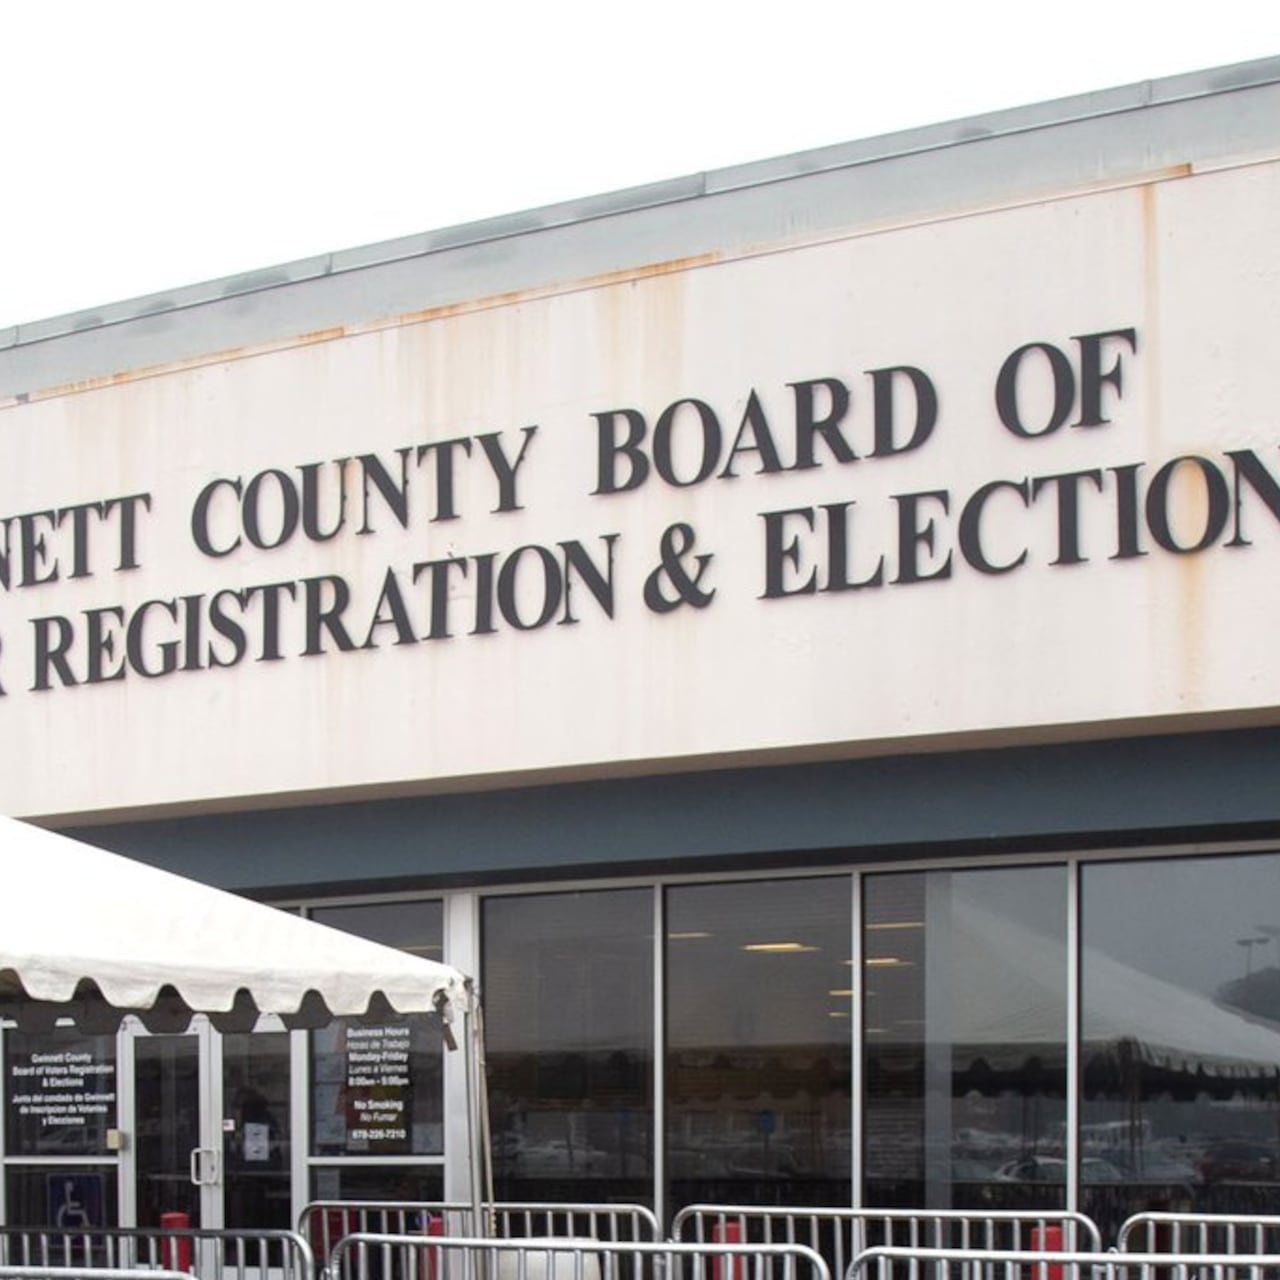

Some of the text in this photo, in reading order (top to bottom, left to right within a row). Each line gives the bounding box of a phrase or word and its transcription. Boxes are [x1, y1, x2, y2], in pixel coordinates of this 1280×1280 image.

[191, 426, 538, 558] COUNTY
[589, 365, 938, 496] BOARD
[995, 327, 1137, 439] OF
[28, 533, 621, 692] REGISTRATION
[642, 522, 716, 613] &
[346, 1026, 410, 1038] Business Hours
[65, 1052, 92, 1063] County
[12, 1065, 35, 1076] Board
[353, 1100, 403, 1112] No Smoking
